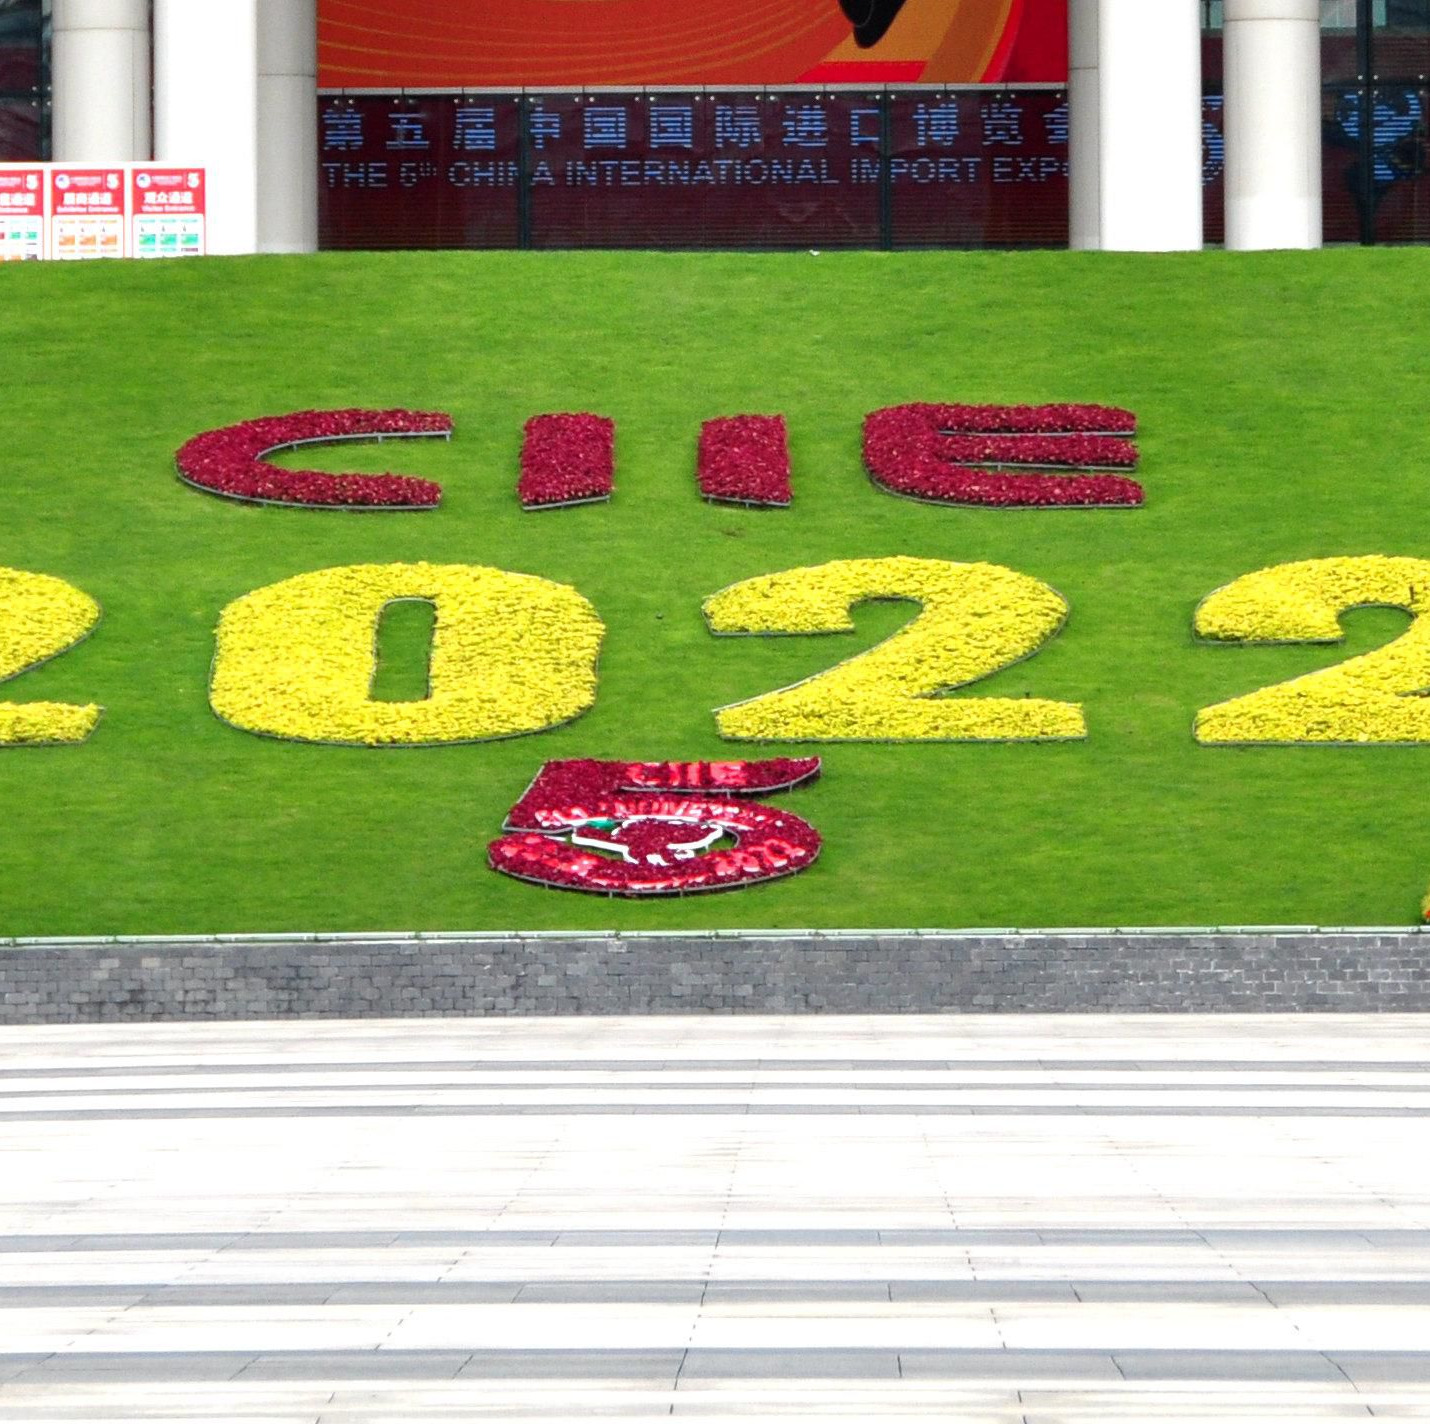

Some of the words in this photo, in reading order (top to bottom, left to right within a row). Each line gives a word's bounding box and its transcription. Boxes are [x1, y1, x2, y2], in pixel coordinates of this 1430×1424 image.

[322, 162, 387, 187] THE
[566, 159, 841, 185] INTERNATIONAL
[993, 156, 1069, 183] EXP
[176, 403, 1144, 510] CIIE
[486, 756, 821, 895] 5
